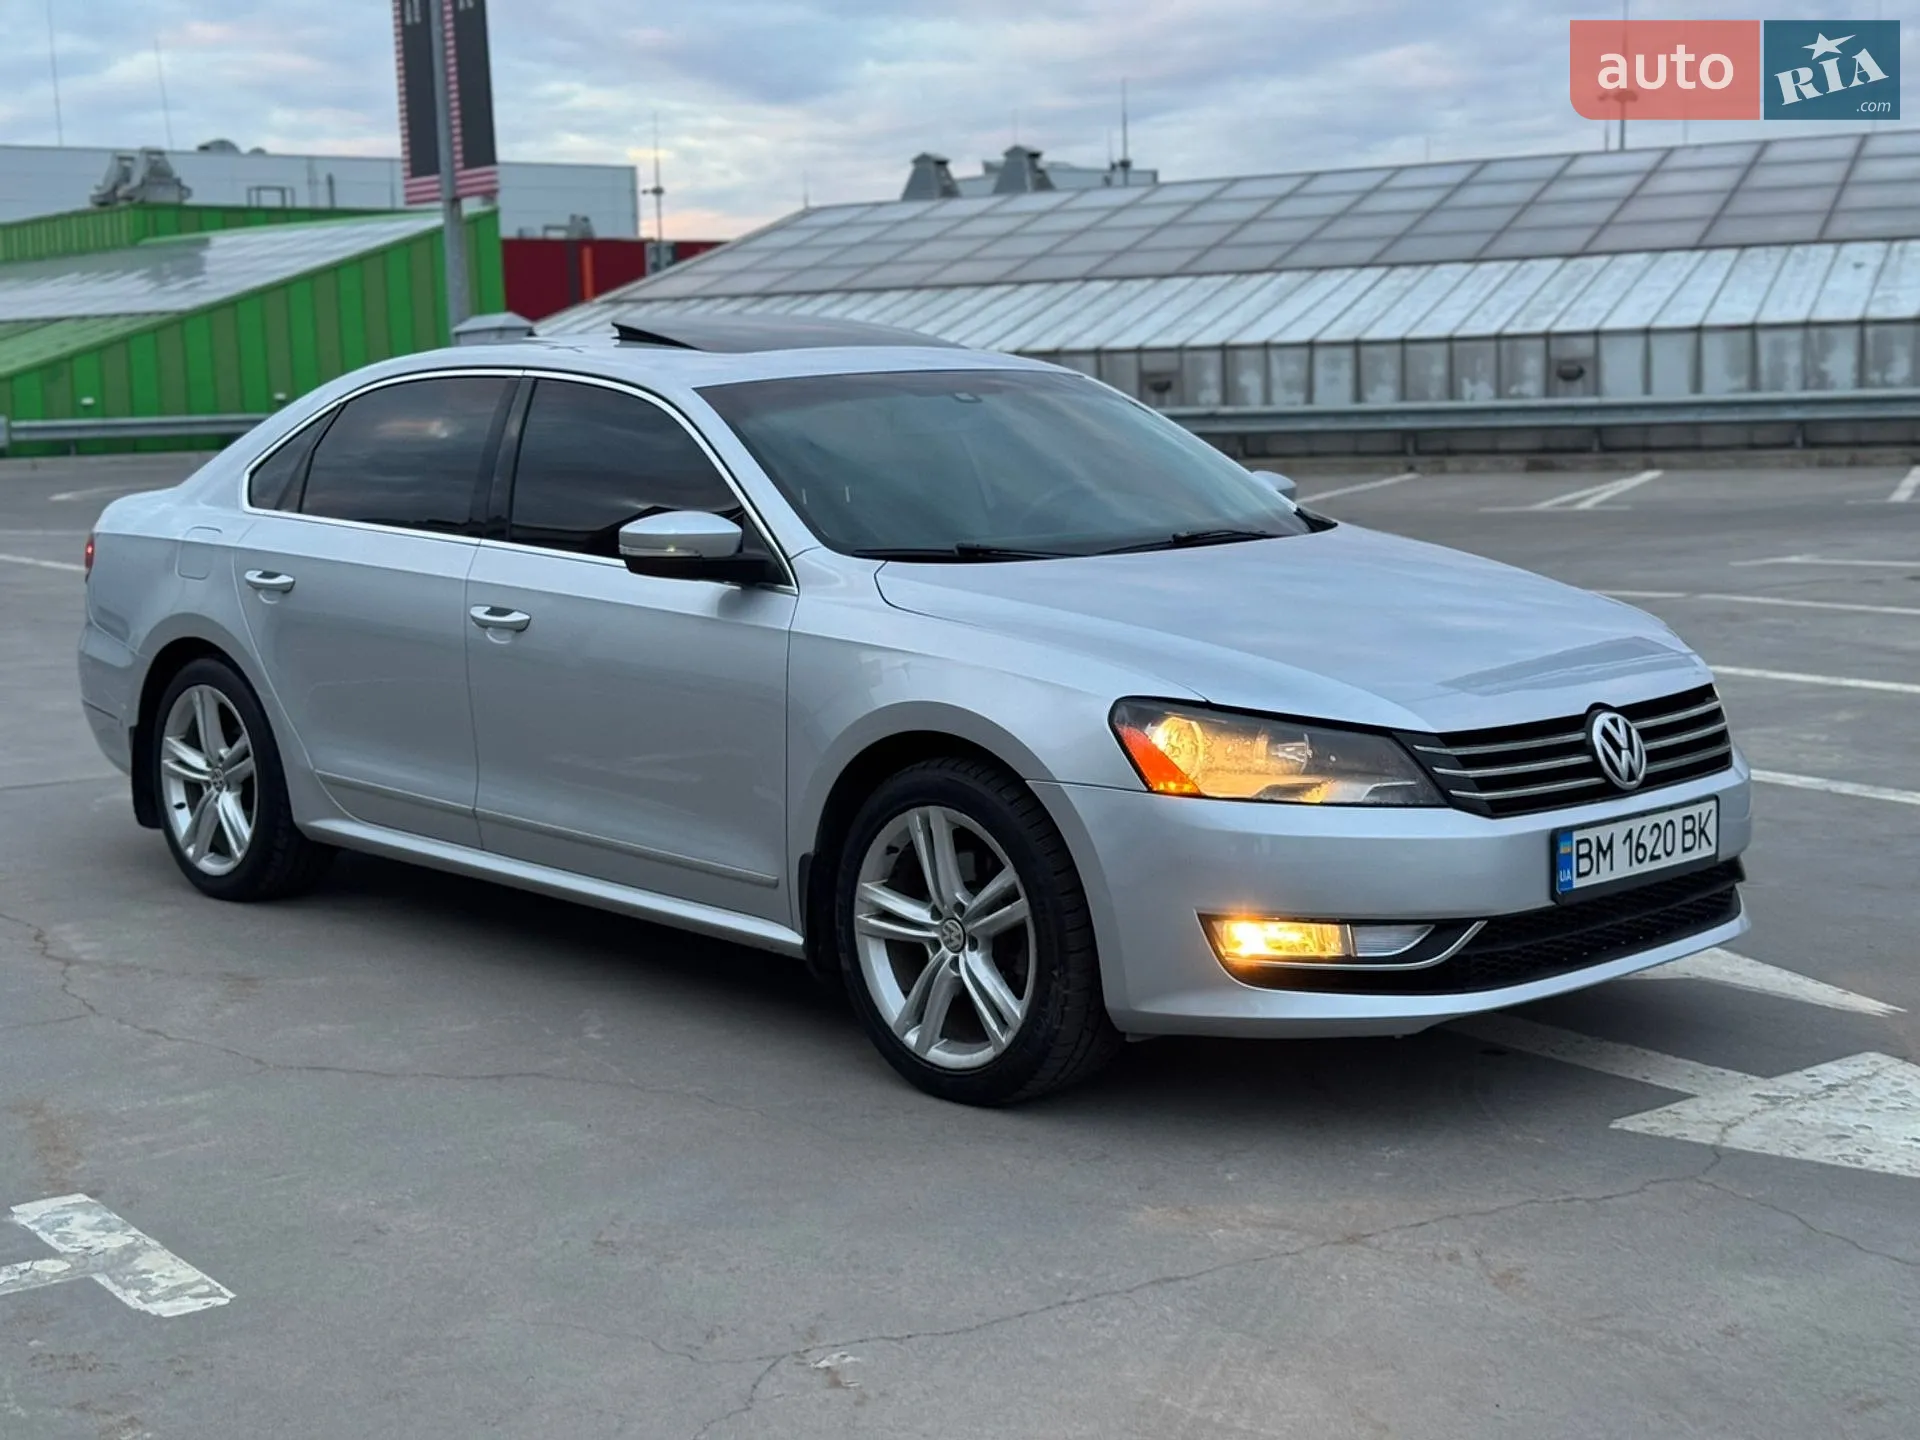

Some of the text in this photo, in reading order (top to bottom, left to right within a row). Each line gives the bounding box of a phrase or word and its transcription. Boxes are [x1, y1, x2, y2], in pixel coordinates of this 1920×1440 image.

[1575, 809, 1713, 879] BM 1620 BK
[1559, 869, 1572, 882] UA
